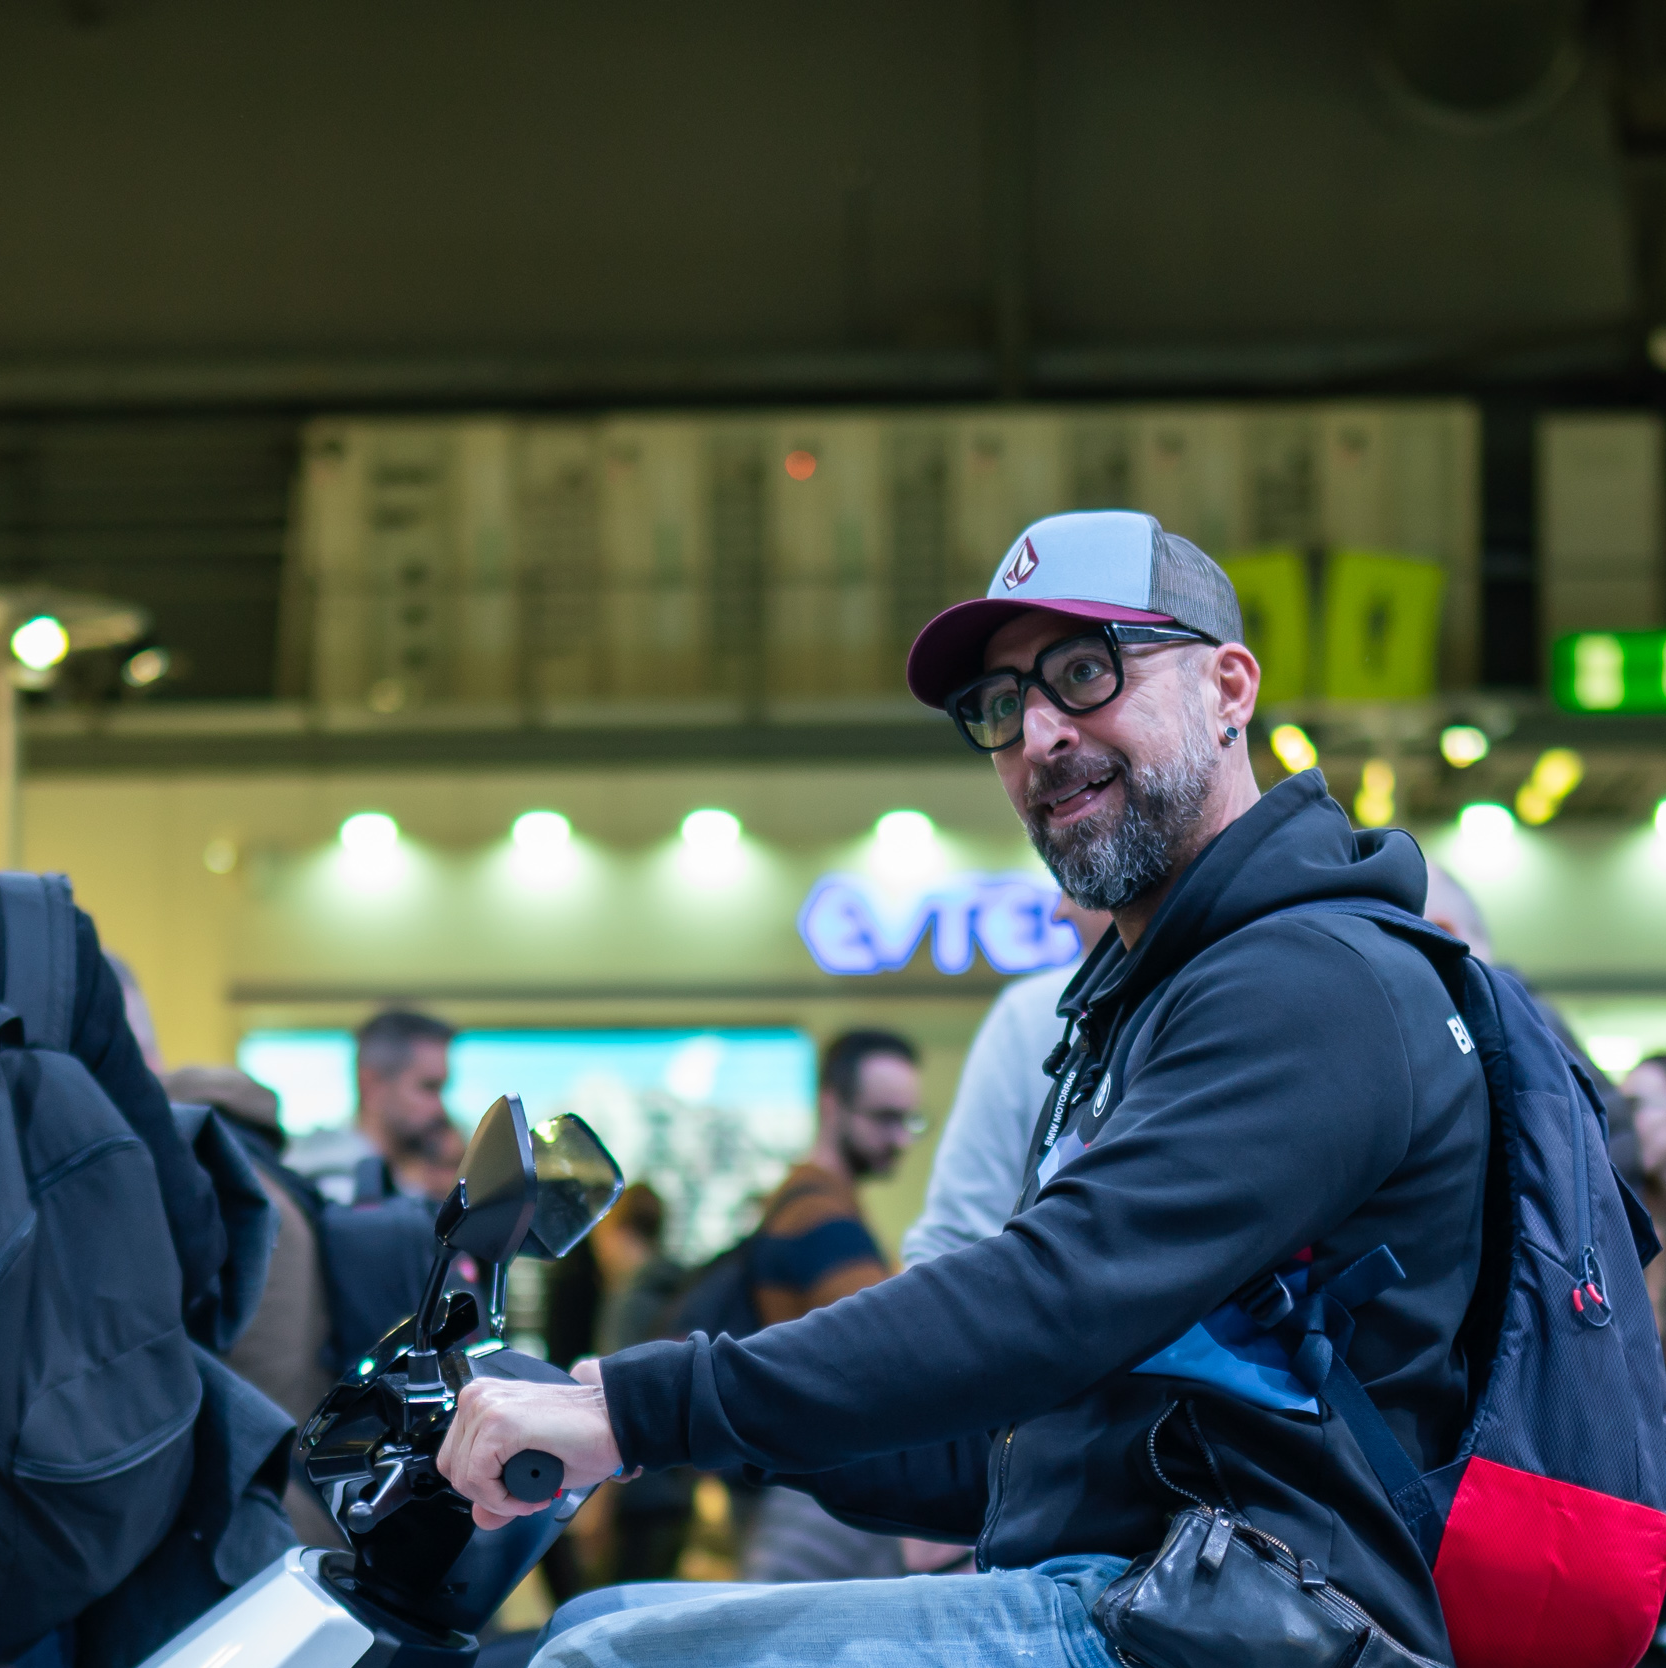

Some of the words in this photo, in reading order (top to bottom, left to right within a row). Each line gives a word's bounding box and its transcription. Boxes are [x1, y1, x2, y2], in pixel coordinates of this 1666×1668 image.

[1446, 1015, 1476, 1055] B
[1044, 1123, 1060, 1148] BMW
[1053, 1071, 1077, 1124] MOTORRAD
